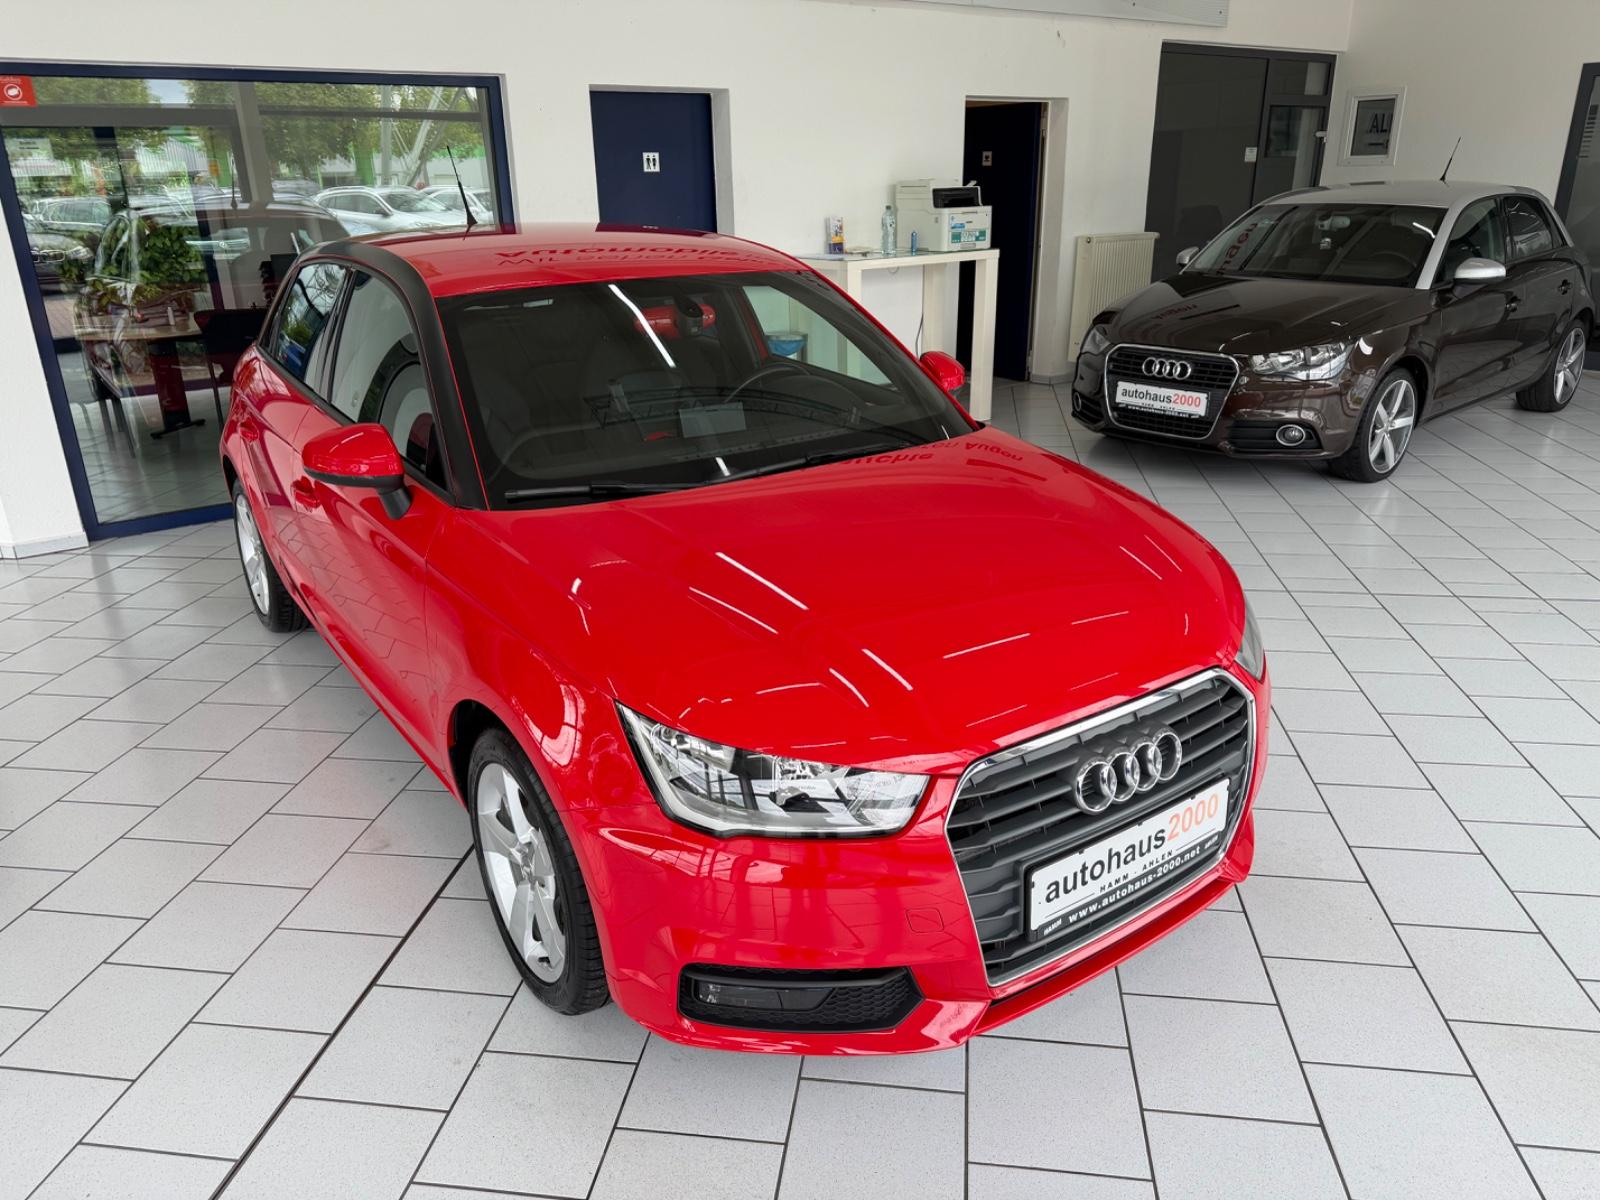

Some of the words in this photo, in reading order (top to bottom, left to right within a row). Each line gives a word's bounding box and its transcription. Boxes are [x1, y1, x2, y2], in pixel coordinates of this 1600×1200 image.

[1121, 388, 1201, 408] autohaus2000
[1045, 793, 1219, 903] autohaus2000
[1100, 872, 1129, 893] HAMM
[1142, 850, 1173, 872] AHLEN
[1068, 846, 1200, 923] www.autohaus-2000.net
